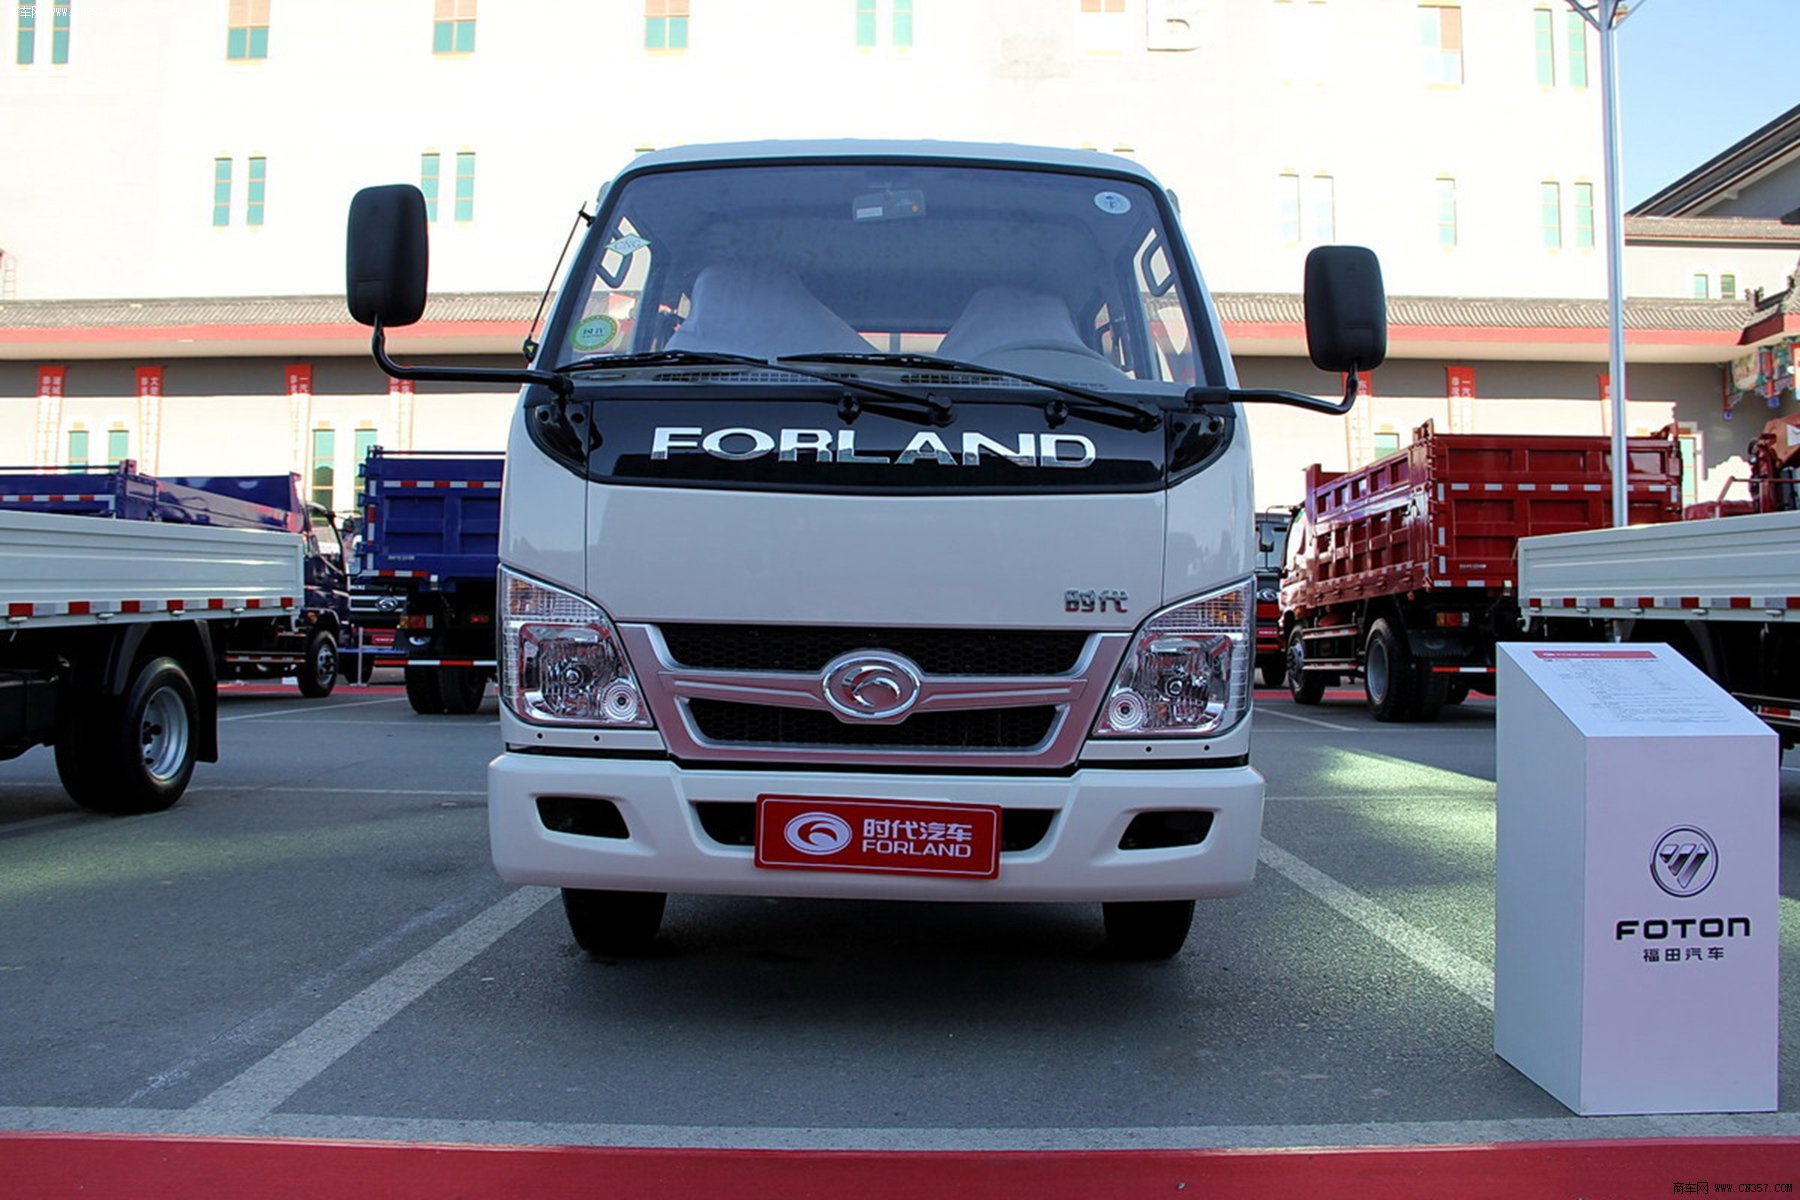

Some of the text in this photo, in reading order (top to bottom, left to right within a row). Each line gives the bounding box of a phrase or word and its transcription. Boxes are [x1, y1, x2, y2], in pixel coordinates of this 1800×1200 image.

[651, 427, 1097, 468] FORLAND
[863, 818, 973, 841] 时代汽车
[862, 840, 972, 858] FORLAND
[1616, 917, 1751, 941] FOTON
[1643, 947, 1724, 962] 福田汽车
